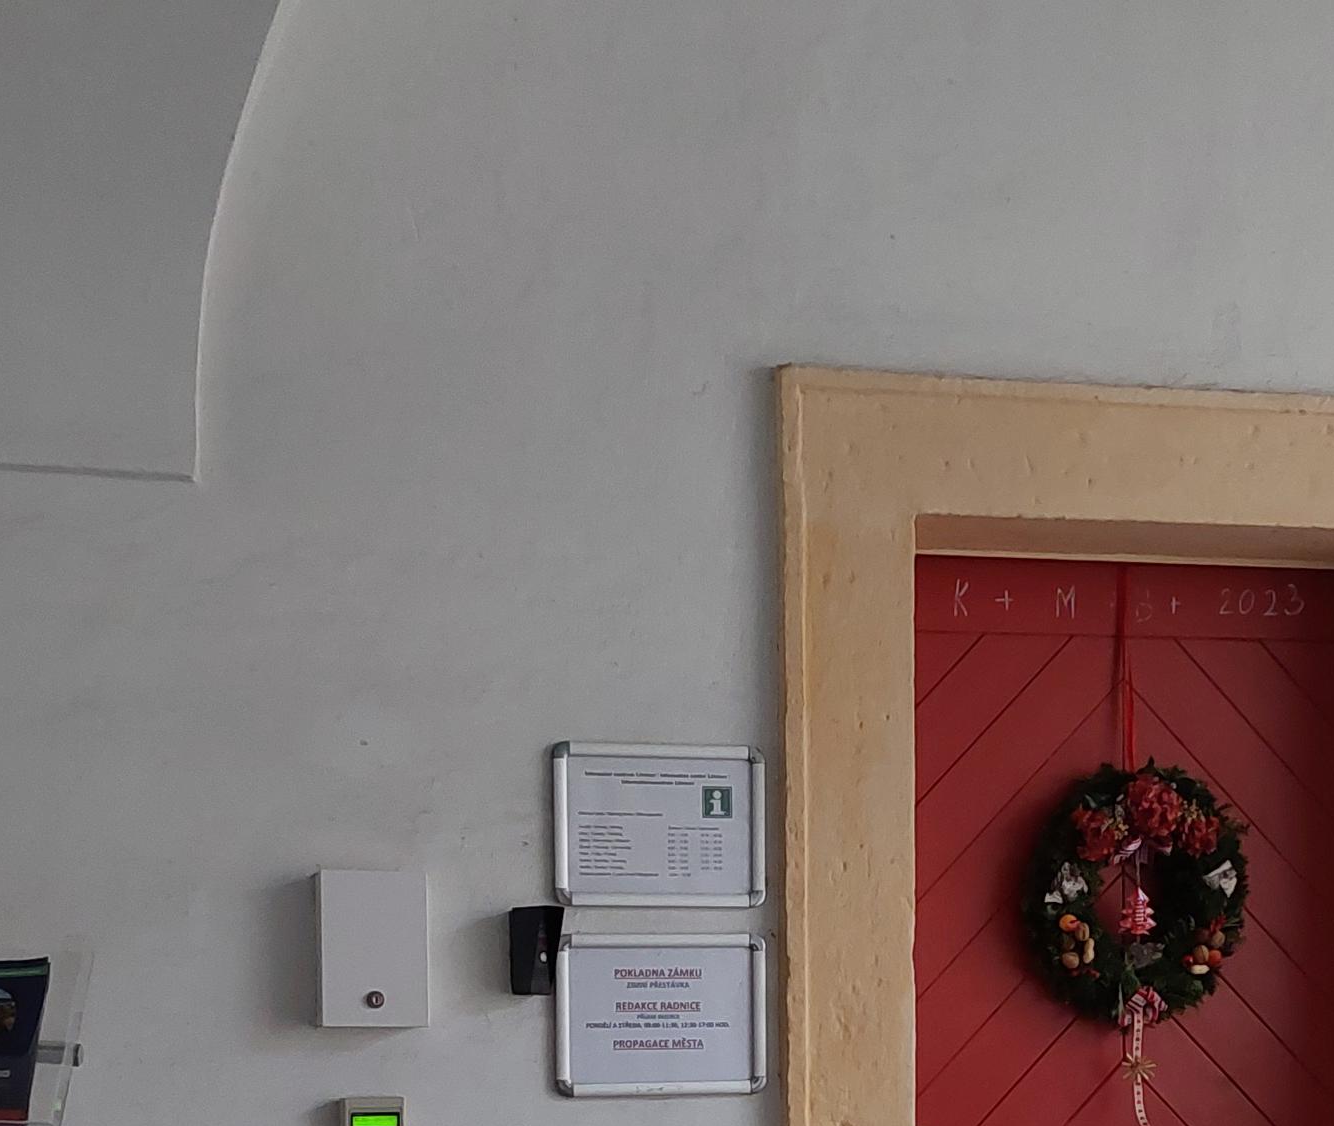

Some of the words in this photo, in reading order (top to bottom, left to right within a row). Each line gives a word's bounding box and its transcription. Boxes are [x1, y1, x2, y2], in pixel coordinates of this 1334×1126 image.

[953, 577, 970, 618] K
[1054, 585, 1077, 619] M
[1218, 584, 1307, 618] 2023
[614, 968, 666, 979] POKLADNA
[667, 967, 703, 979] ZÁMKU
[649, 980, 690, 989] PŘESTÁVKA
[615, 1001, 659, 1011] REDAKCE
[661, 1001, 701, 1011] RADNICE
[613, 1039, 670, 1049] PROPAGACE
[672, 1037, 704, 1049] MĚSTA
